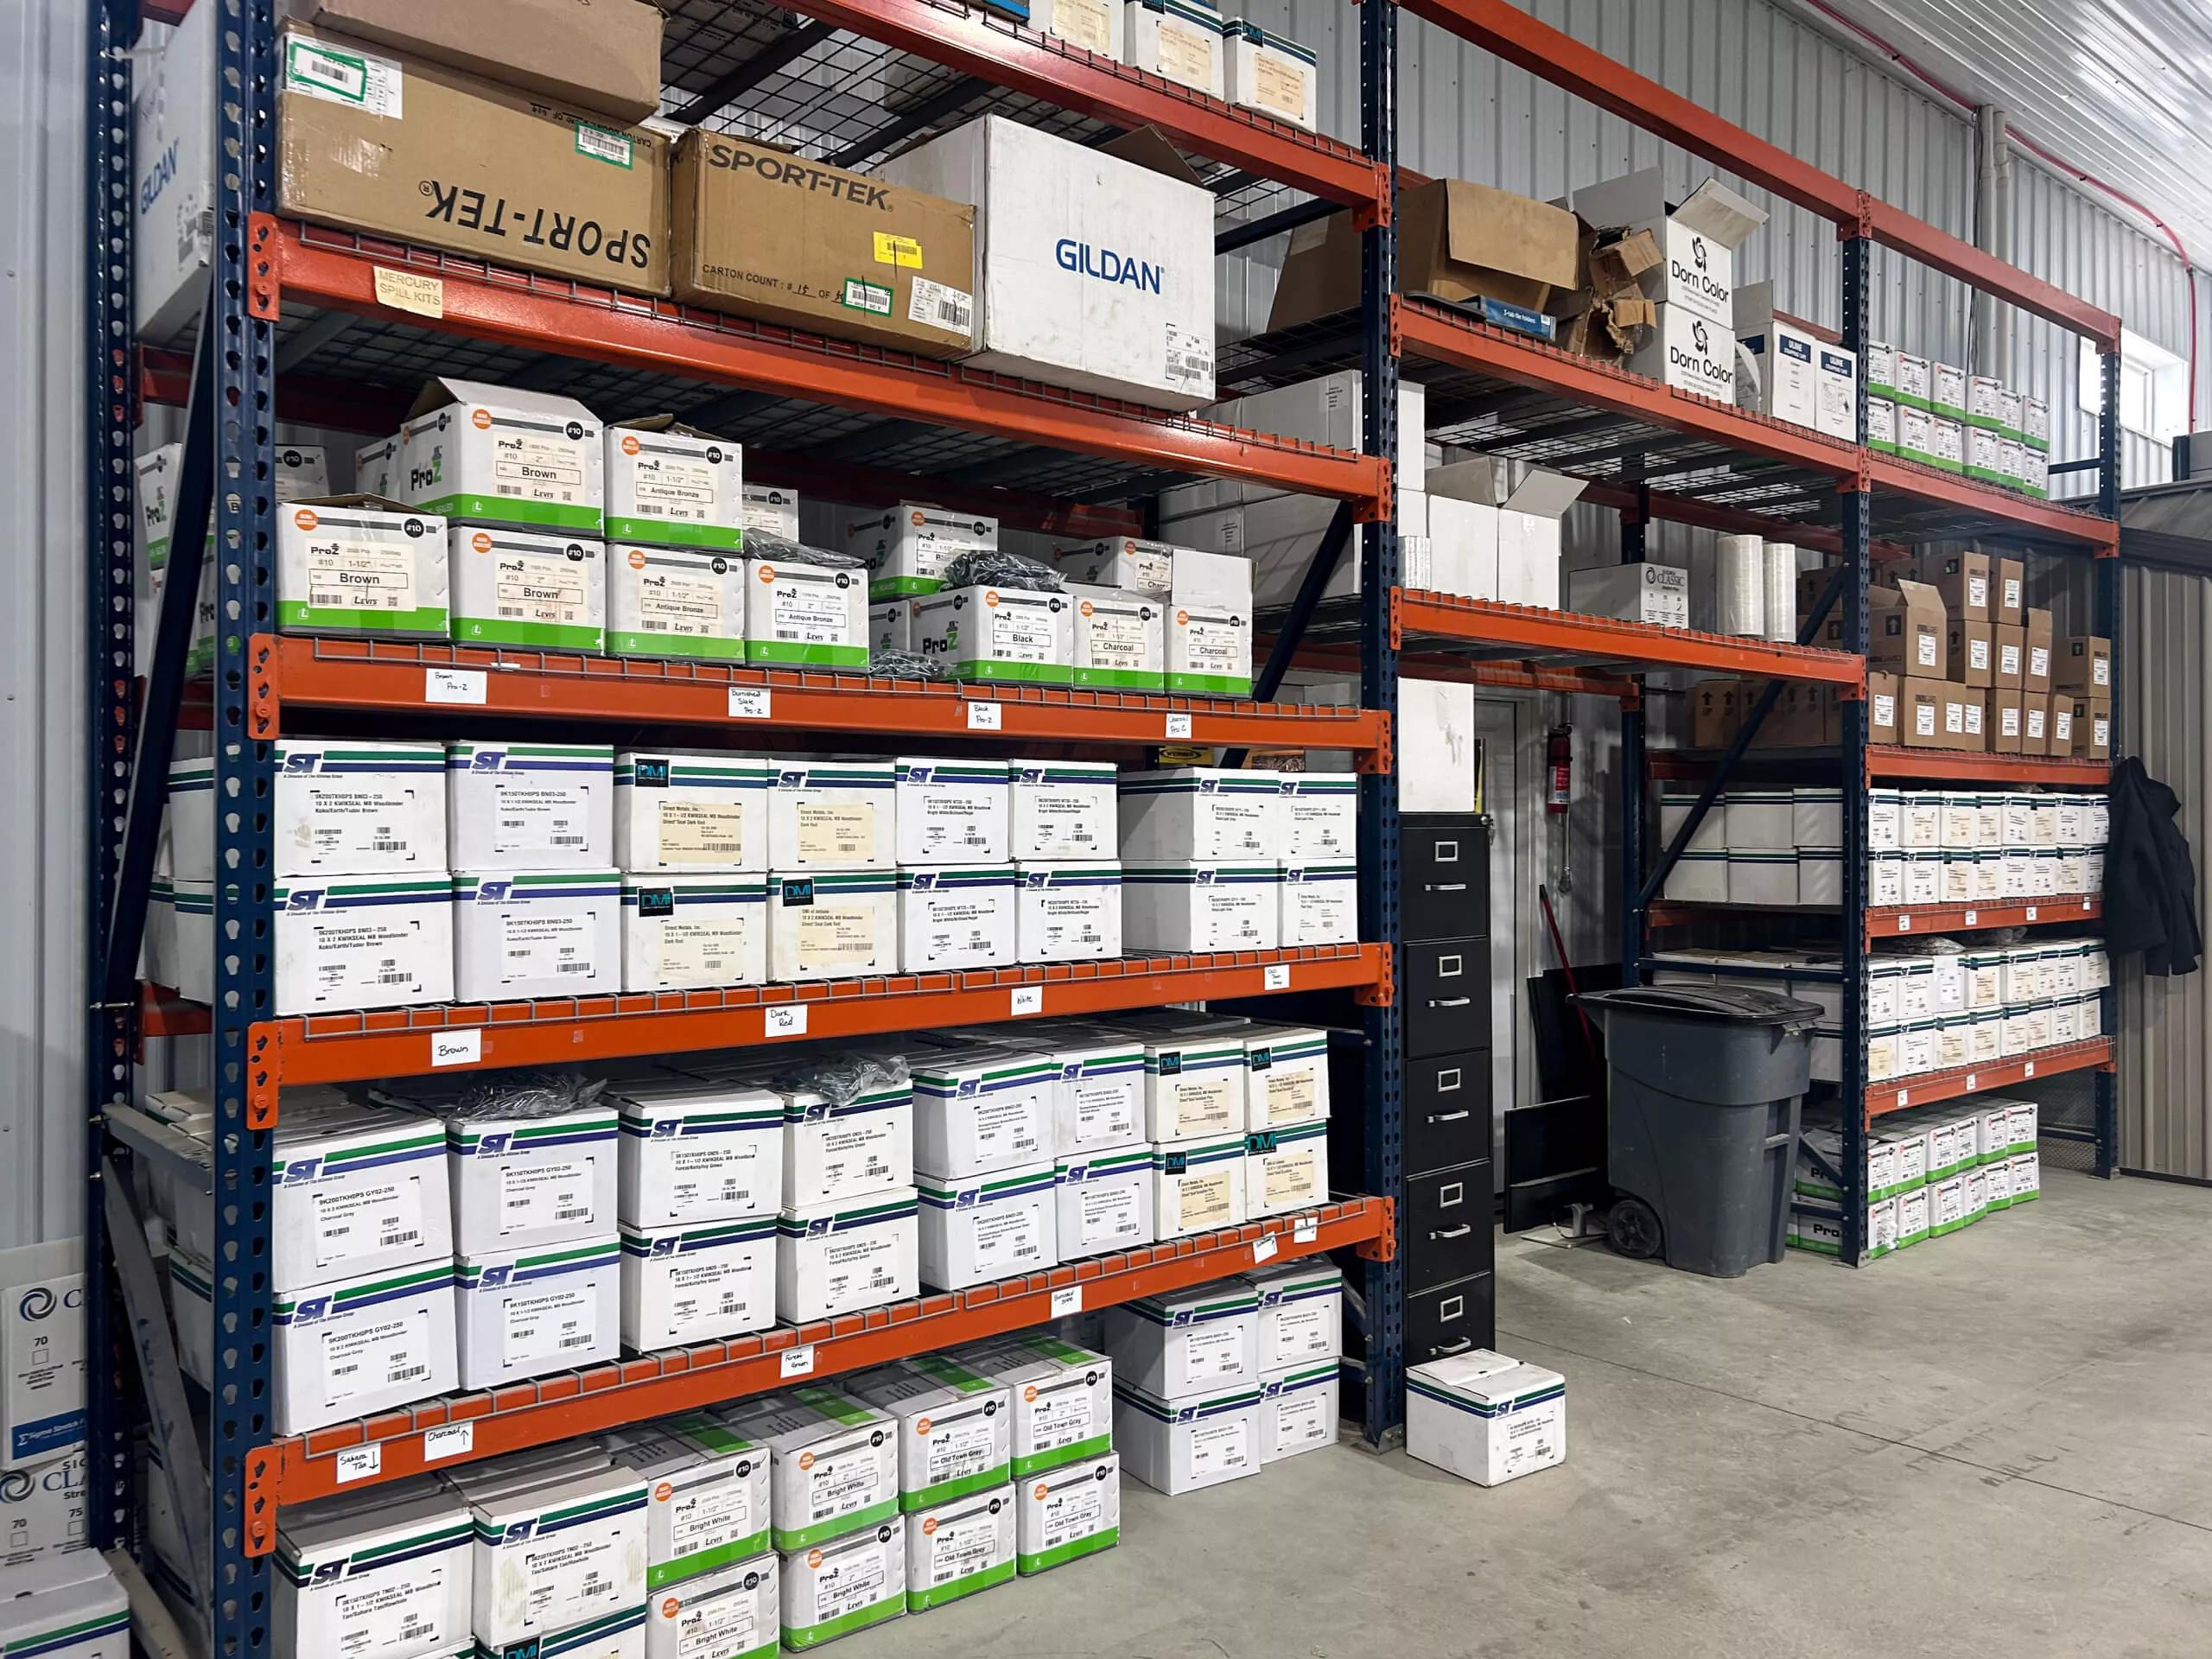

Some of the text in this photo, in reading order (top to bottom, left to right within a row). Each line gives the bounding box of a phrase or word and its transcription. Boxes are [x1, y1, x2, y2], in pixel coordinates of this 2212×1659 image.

[378, 270, 439, 292] MERCURY
[702, 264, 744, 281] CARTON
[746, 273, 779, 289] COUNT
[818, 289, 830, 300] OF
[1672, 260, 1699, 289] Dorn
[1702, 276, 1729, 302] Color
[379, 283, 441, 306] SPILL KITS
[1670, 346, 1700, 372] Dorn
[1703, 359, 1733, 384] Color
[522, 467, 557, 479] Brown
[651, 486, 700, 499] Antique Bronze
[340, 573, 380, 584] Brown
[524, 588, 559, 599] Brown
[656, 603, 681, 612] Antique
[1013, 634, 1033, 643] Black
[1103, 643, 1135, 652] Charcoal
[284, 753, 321, 773] ST
[472, 752, 506, 770] ST
[779, 772, 806, 787] ST
[908, 767, 932, 782] ST
[1020, 768, 1042, 783] ST
[1198, 779, 1218, 792] ST
[1279, 782, 1296, 795] ST
[912, 874, 936, 889] ST
[1026, 873, 1049, 887] ST
[1196, 870, 1215, 884] ST
[1287, 869, 1303, 882] ST
[477, 881, 512, 900] ST
[785, 884, 811, 897] DMI
[287, 890, 326, 911] ST
[1017, 995, 1033, 1005] White
[779, 1017, 793, 1027] Red
[438, 1045, 470, 1058] Brown
[1251, 1052, 1271, 1066] DMI
[1160, 1056, 1180, 1069] DMI
[1061, 1064, 1083, 1079] ST
[957, 1078, 981, 1096] ST
[804, 1103, 830, 1122] ST
[651, 1119, 683, 1138] ST
[477, 1133, 512, 1154] ST
[1247, 1133, 1276, 1152] DMI
[1166, 1155, 1185, 1168] DMI
[283, 1158, 323, 1183] ST
[806, 1217, 833, 1236] ST
[651, 1236, 680, 1255] ST
[479, 1265, 514, 1287] ST
[293, 1295, 333, 1323] ST
[34, 1336, 48, 1347] 70
[1043, 1416, 1082, 1432] Old Town Gray
[428, 1427, 461, 1441] Charcoal
[940, 1448, 982, 1464] Old Town Gray
[827, 1480, 865, 1497] Bright White
[69, 1508, 83, 1518] 75
[1054, 1510, 1092, 1528] Old Town Gray
[12, 1518, 27, 1529] 70
[690, 1514, 731, 1533] Bright White
[944, 1546, 985, 1562] Old Town Gray
[832, 1580, 871, 1599] Bright White
[696, 1626, 738, 1645] Bright White
